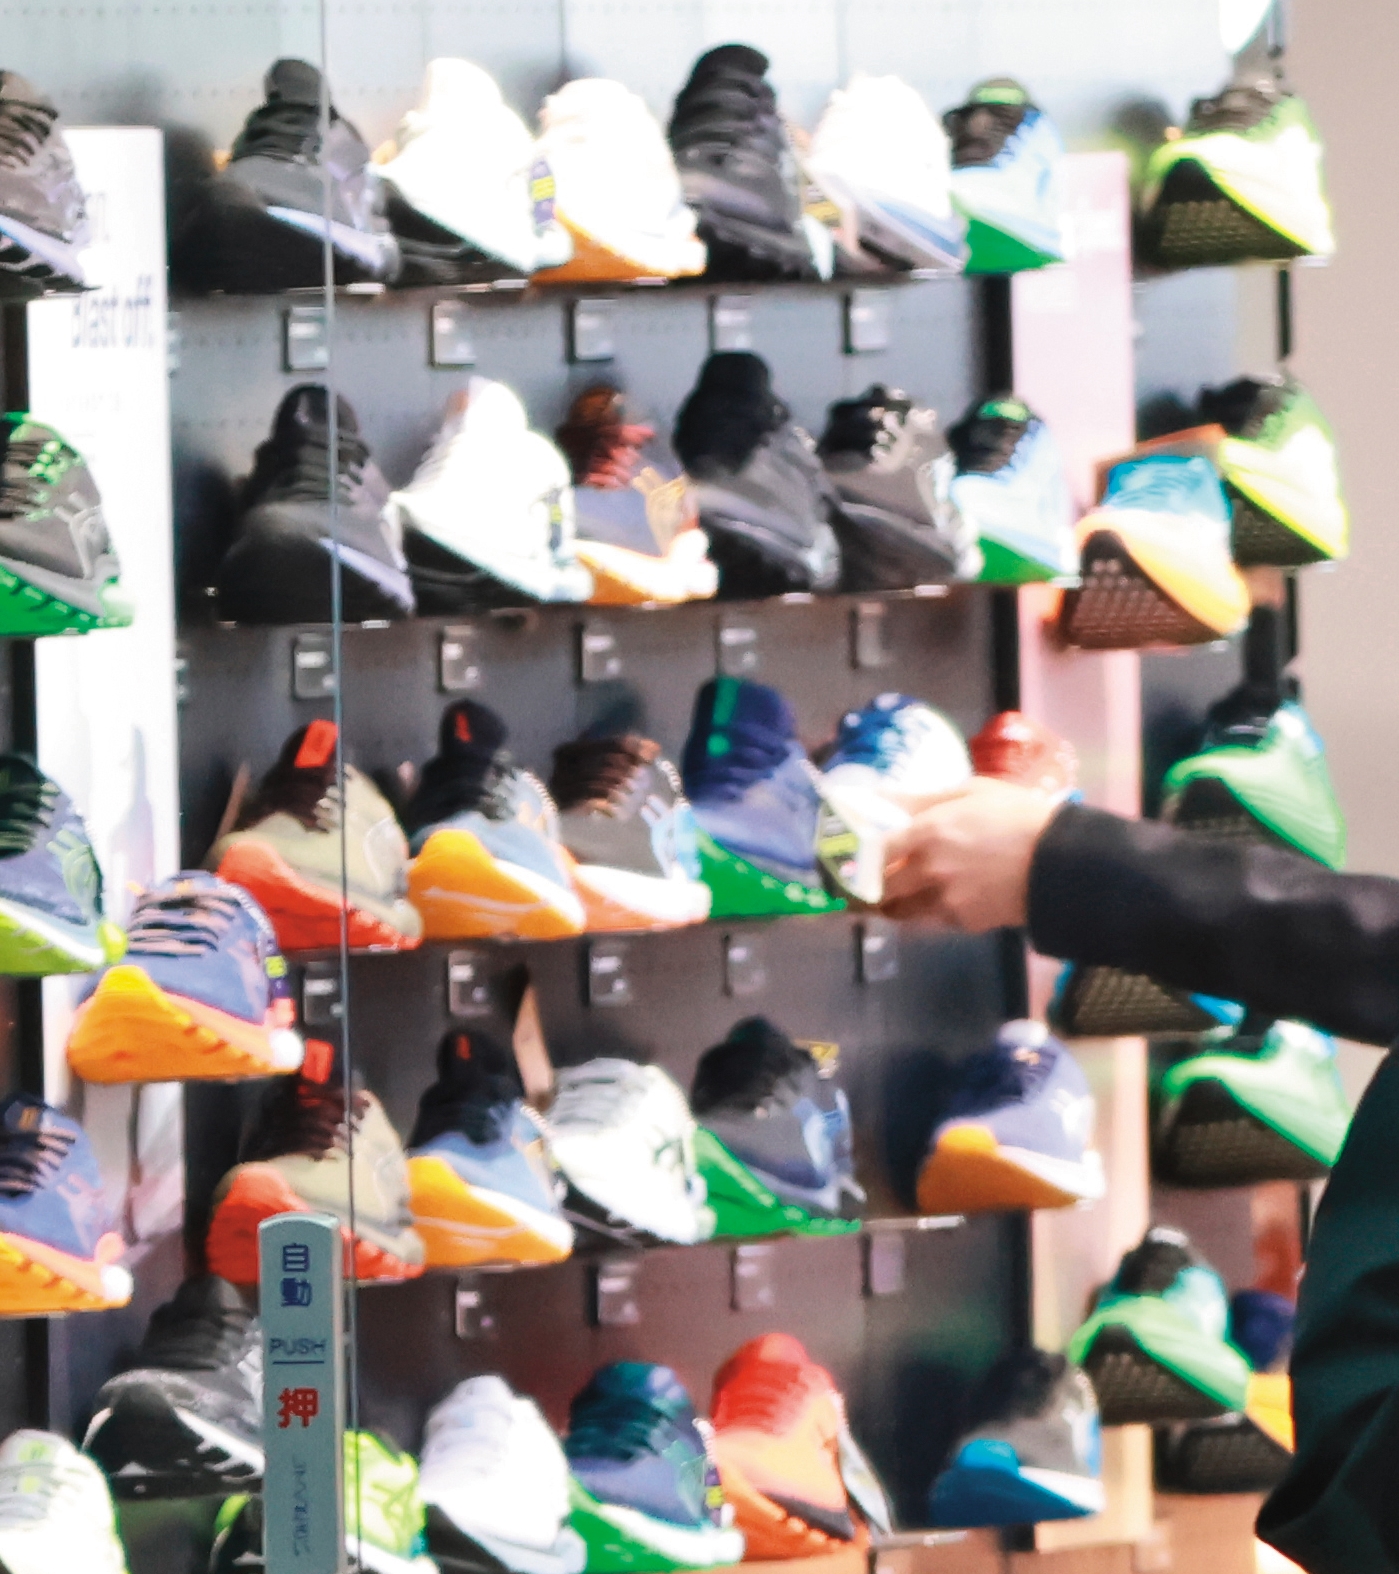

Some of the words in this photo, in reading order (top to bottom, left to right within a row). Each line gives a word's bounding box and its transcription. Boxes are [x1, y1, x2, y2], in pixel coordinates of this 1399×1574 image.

[280, 1243, 313, 1308] 自動
[269, 1337, 326, 1356] PUSH
[277, 1386, 320, 1429] 押
